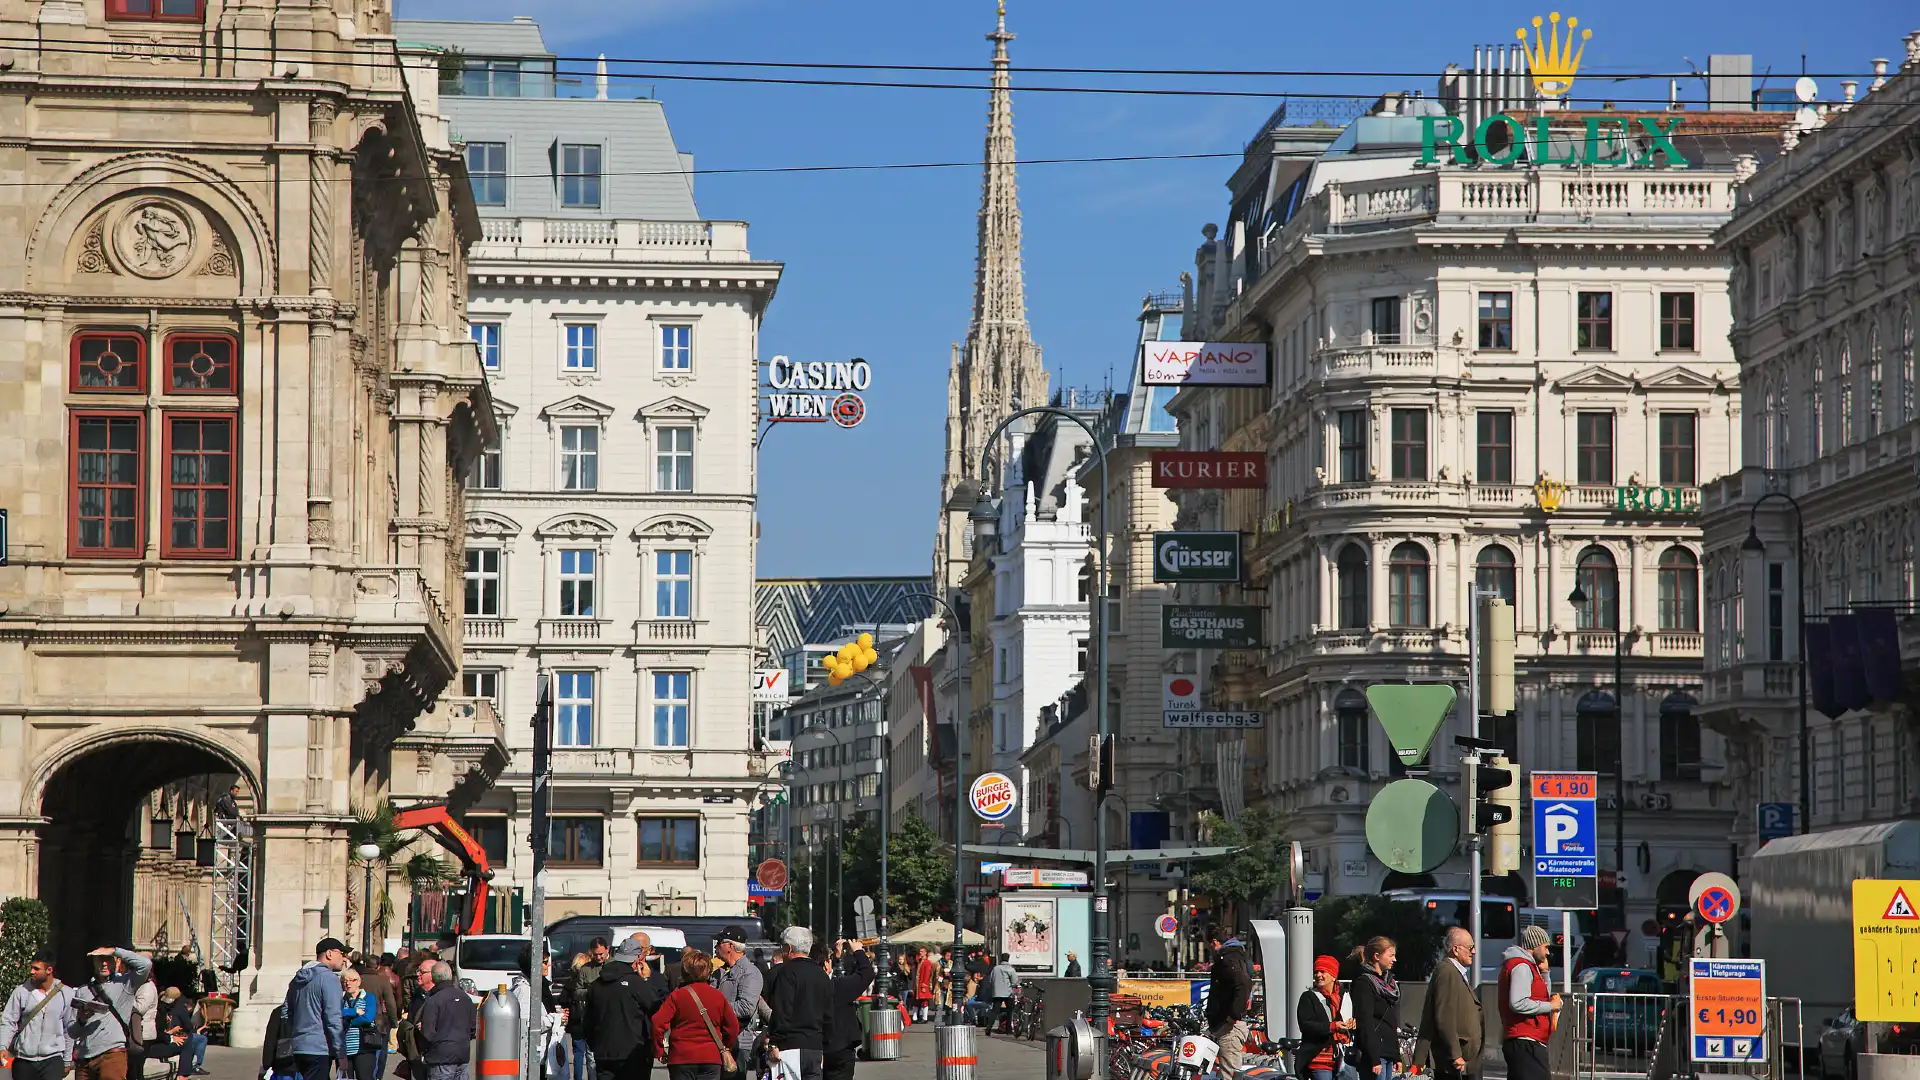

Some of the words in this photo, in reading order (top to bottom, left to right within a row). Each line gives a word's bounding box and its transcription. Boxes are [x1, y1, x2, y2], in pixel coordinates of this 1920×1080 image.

[1416, 114, 1690, 165] ROLEX
[1153, 348, 1253, 366] VAPIANO
[769, 354, 872, 390] CASINO
[769, 393, 828, 417] WIEN
[1159, 461, 1258, 478] KURIER
[1616, 487, 1703, 512] ROL
[1159, 540, 1232, 573] Gösser
[1169, 618, 1245, 629] GASTHAUS
[1185, 628, 1224, 639] OPER
[1168, 700, 1196, 709] Turek
[976, 782, 1009, 798] BURGER
[1540, 781, 1550, 795] €
[1556, 782, 1589, 798] 1,90
[978, 790, 1011, 809] KING
[1545, 814, 1579, 854] P
[1553, 878, 1576, 887] FREI
[1293, 915, 1310, 924] 111
[1718, 994, 1744, 1002] Stunde
[1698, 1008, 1710, 1023] €
[1716, 1008, 1757, 1027] 1,90
